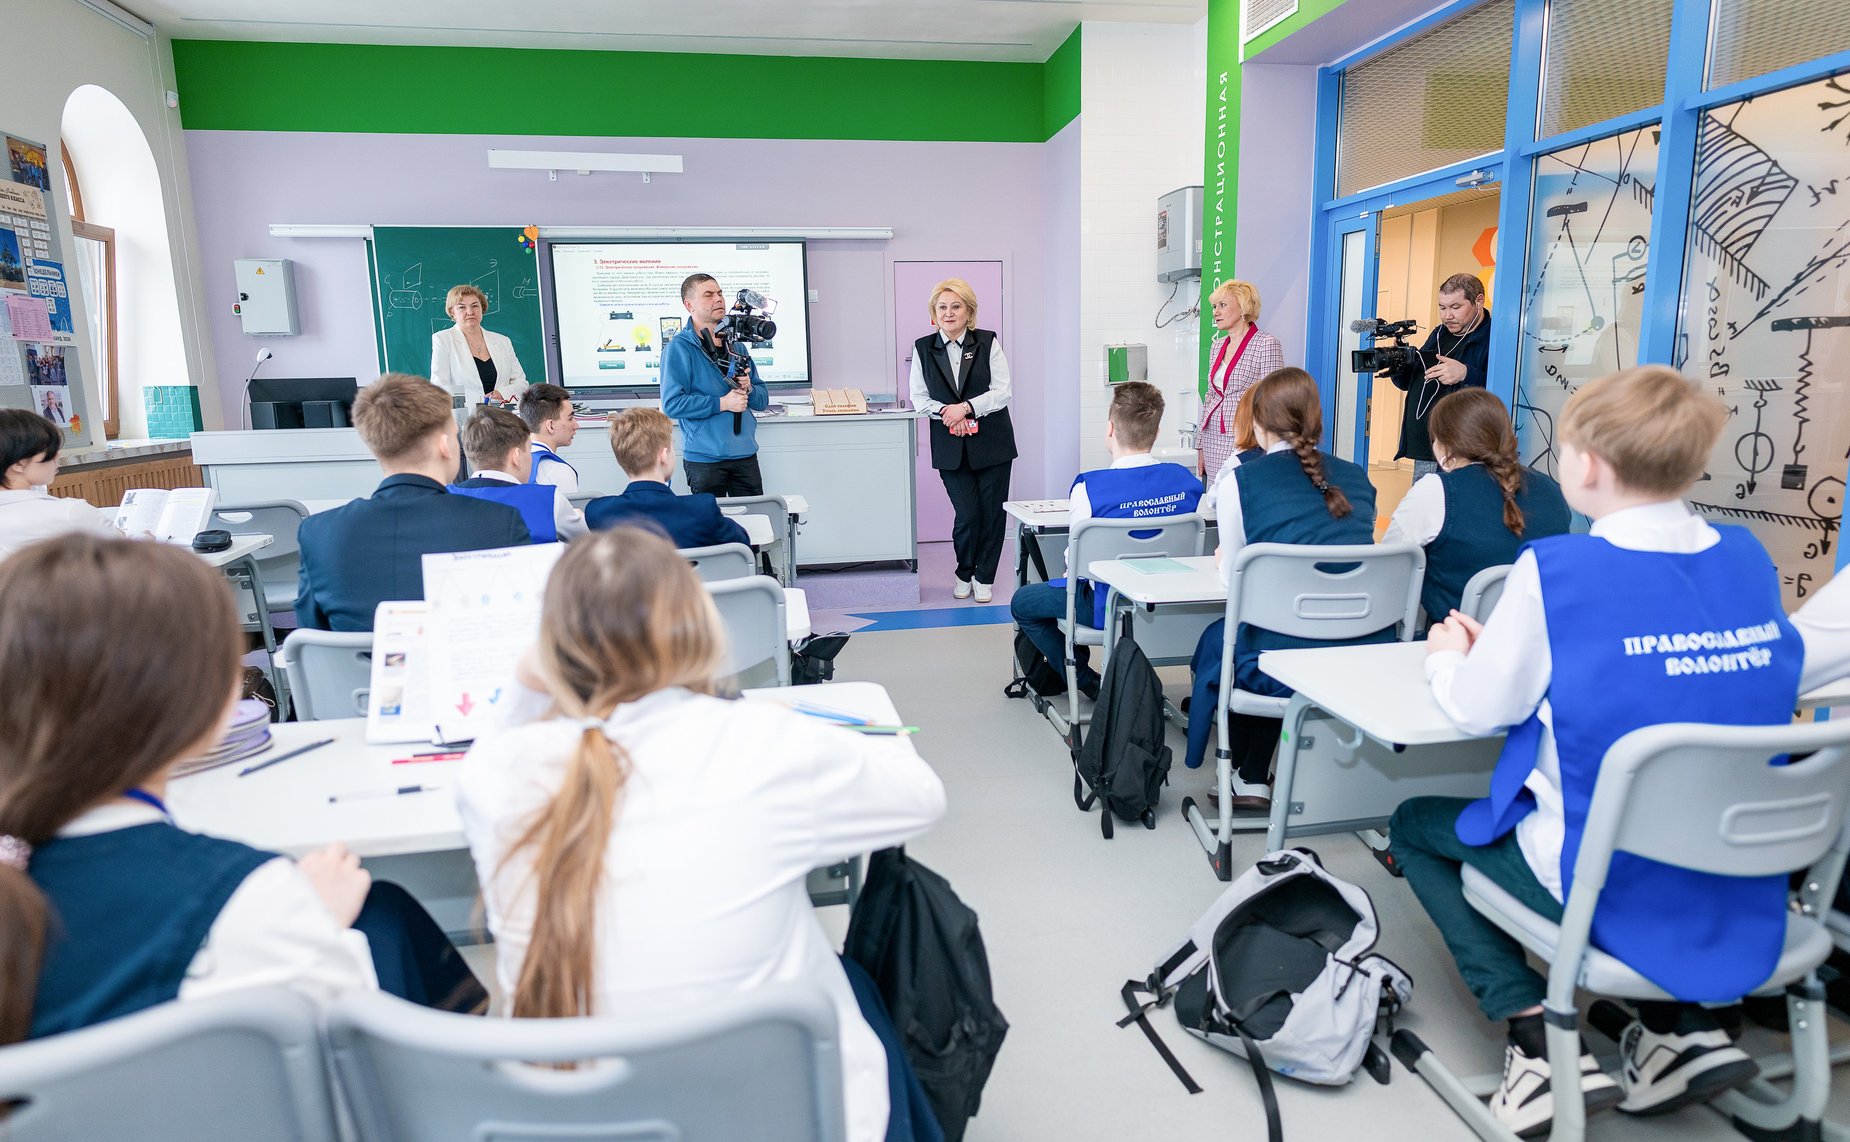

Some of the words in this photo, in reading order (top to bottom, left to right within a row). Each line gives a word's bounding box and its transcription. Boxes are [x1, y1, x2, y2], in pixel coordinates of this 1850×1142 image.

[1211, 71, 1228, 342] ДЕОНСТРАЦИОННАЯ
[1119, 491, 1186, 510] ПРАВОСЛАВНЫЙ
[1133, 504, 1177, 517] ВОЛОНТЁР
[1622, 619, 1783, 656] ПРАВОСЛАВНЫЙ
[1664, 646, 1773, 677] ВОЛОНТЁР
